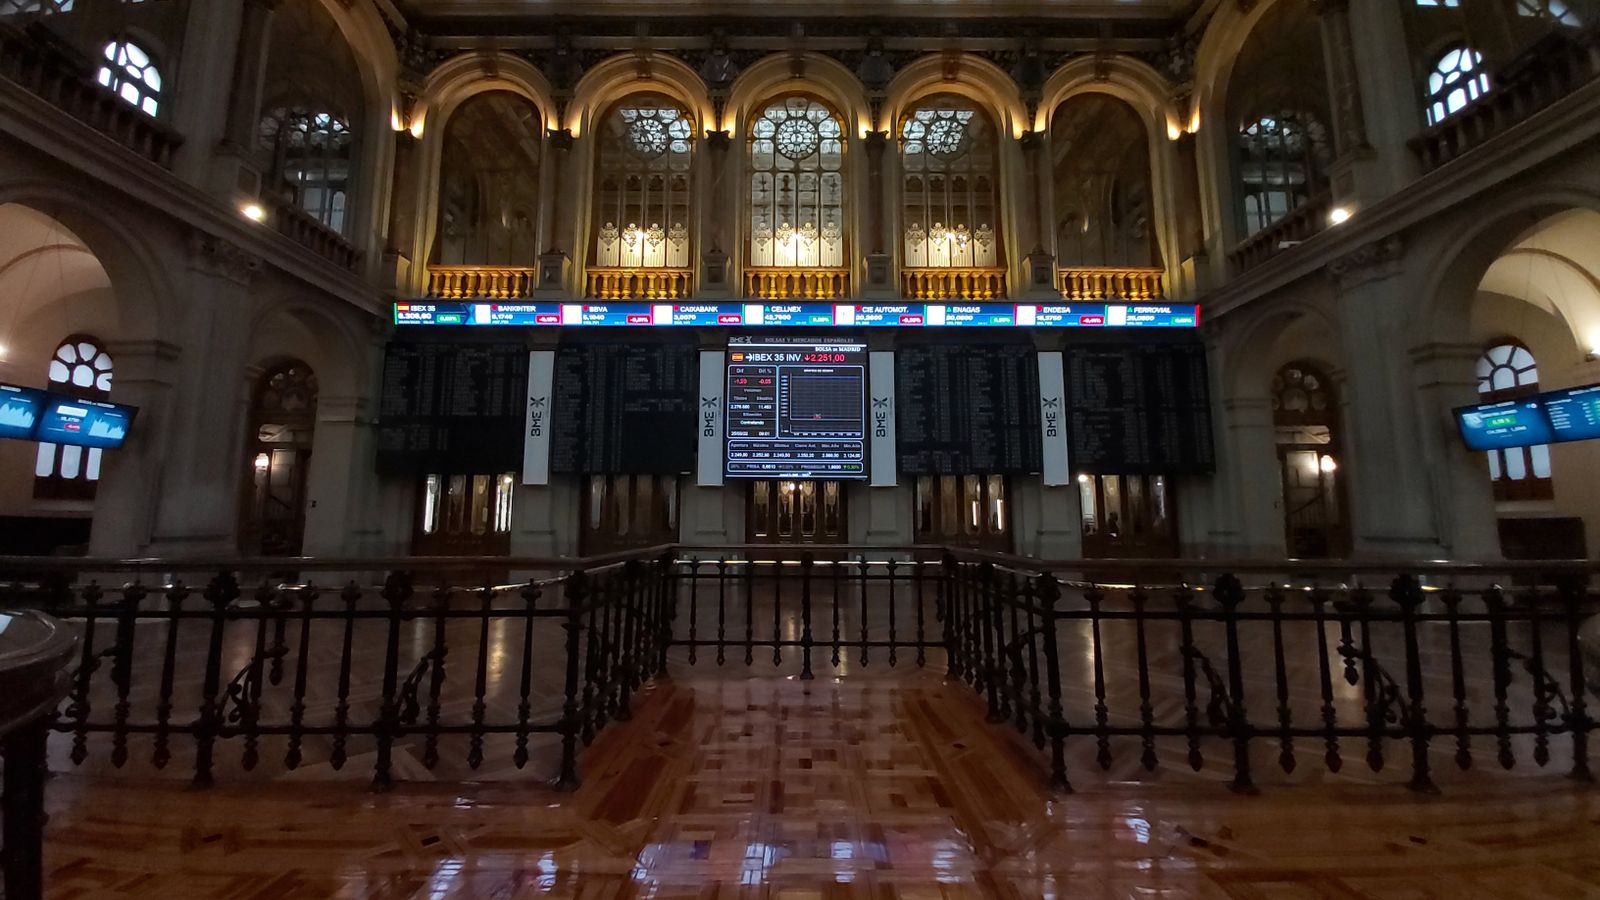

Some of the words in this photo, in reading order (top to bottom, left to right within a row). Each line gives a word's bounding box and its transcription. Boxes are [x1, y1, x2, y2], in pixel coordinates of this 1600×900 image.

[810, 354, 845, 363] 2.251,00
[531, 411, 541, 437] BME
[704, 411, 714, 437] BME
[876, 411, 886, 437] BME
[1046, 411, 1057, 437] BME
